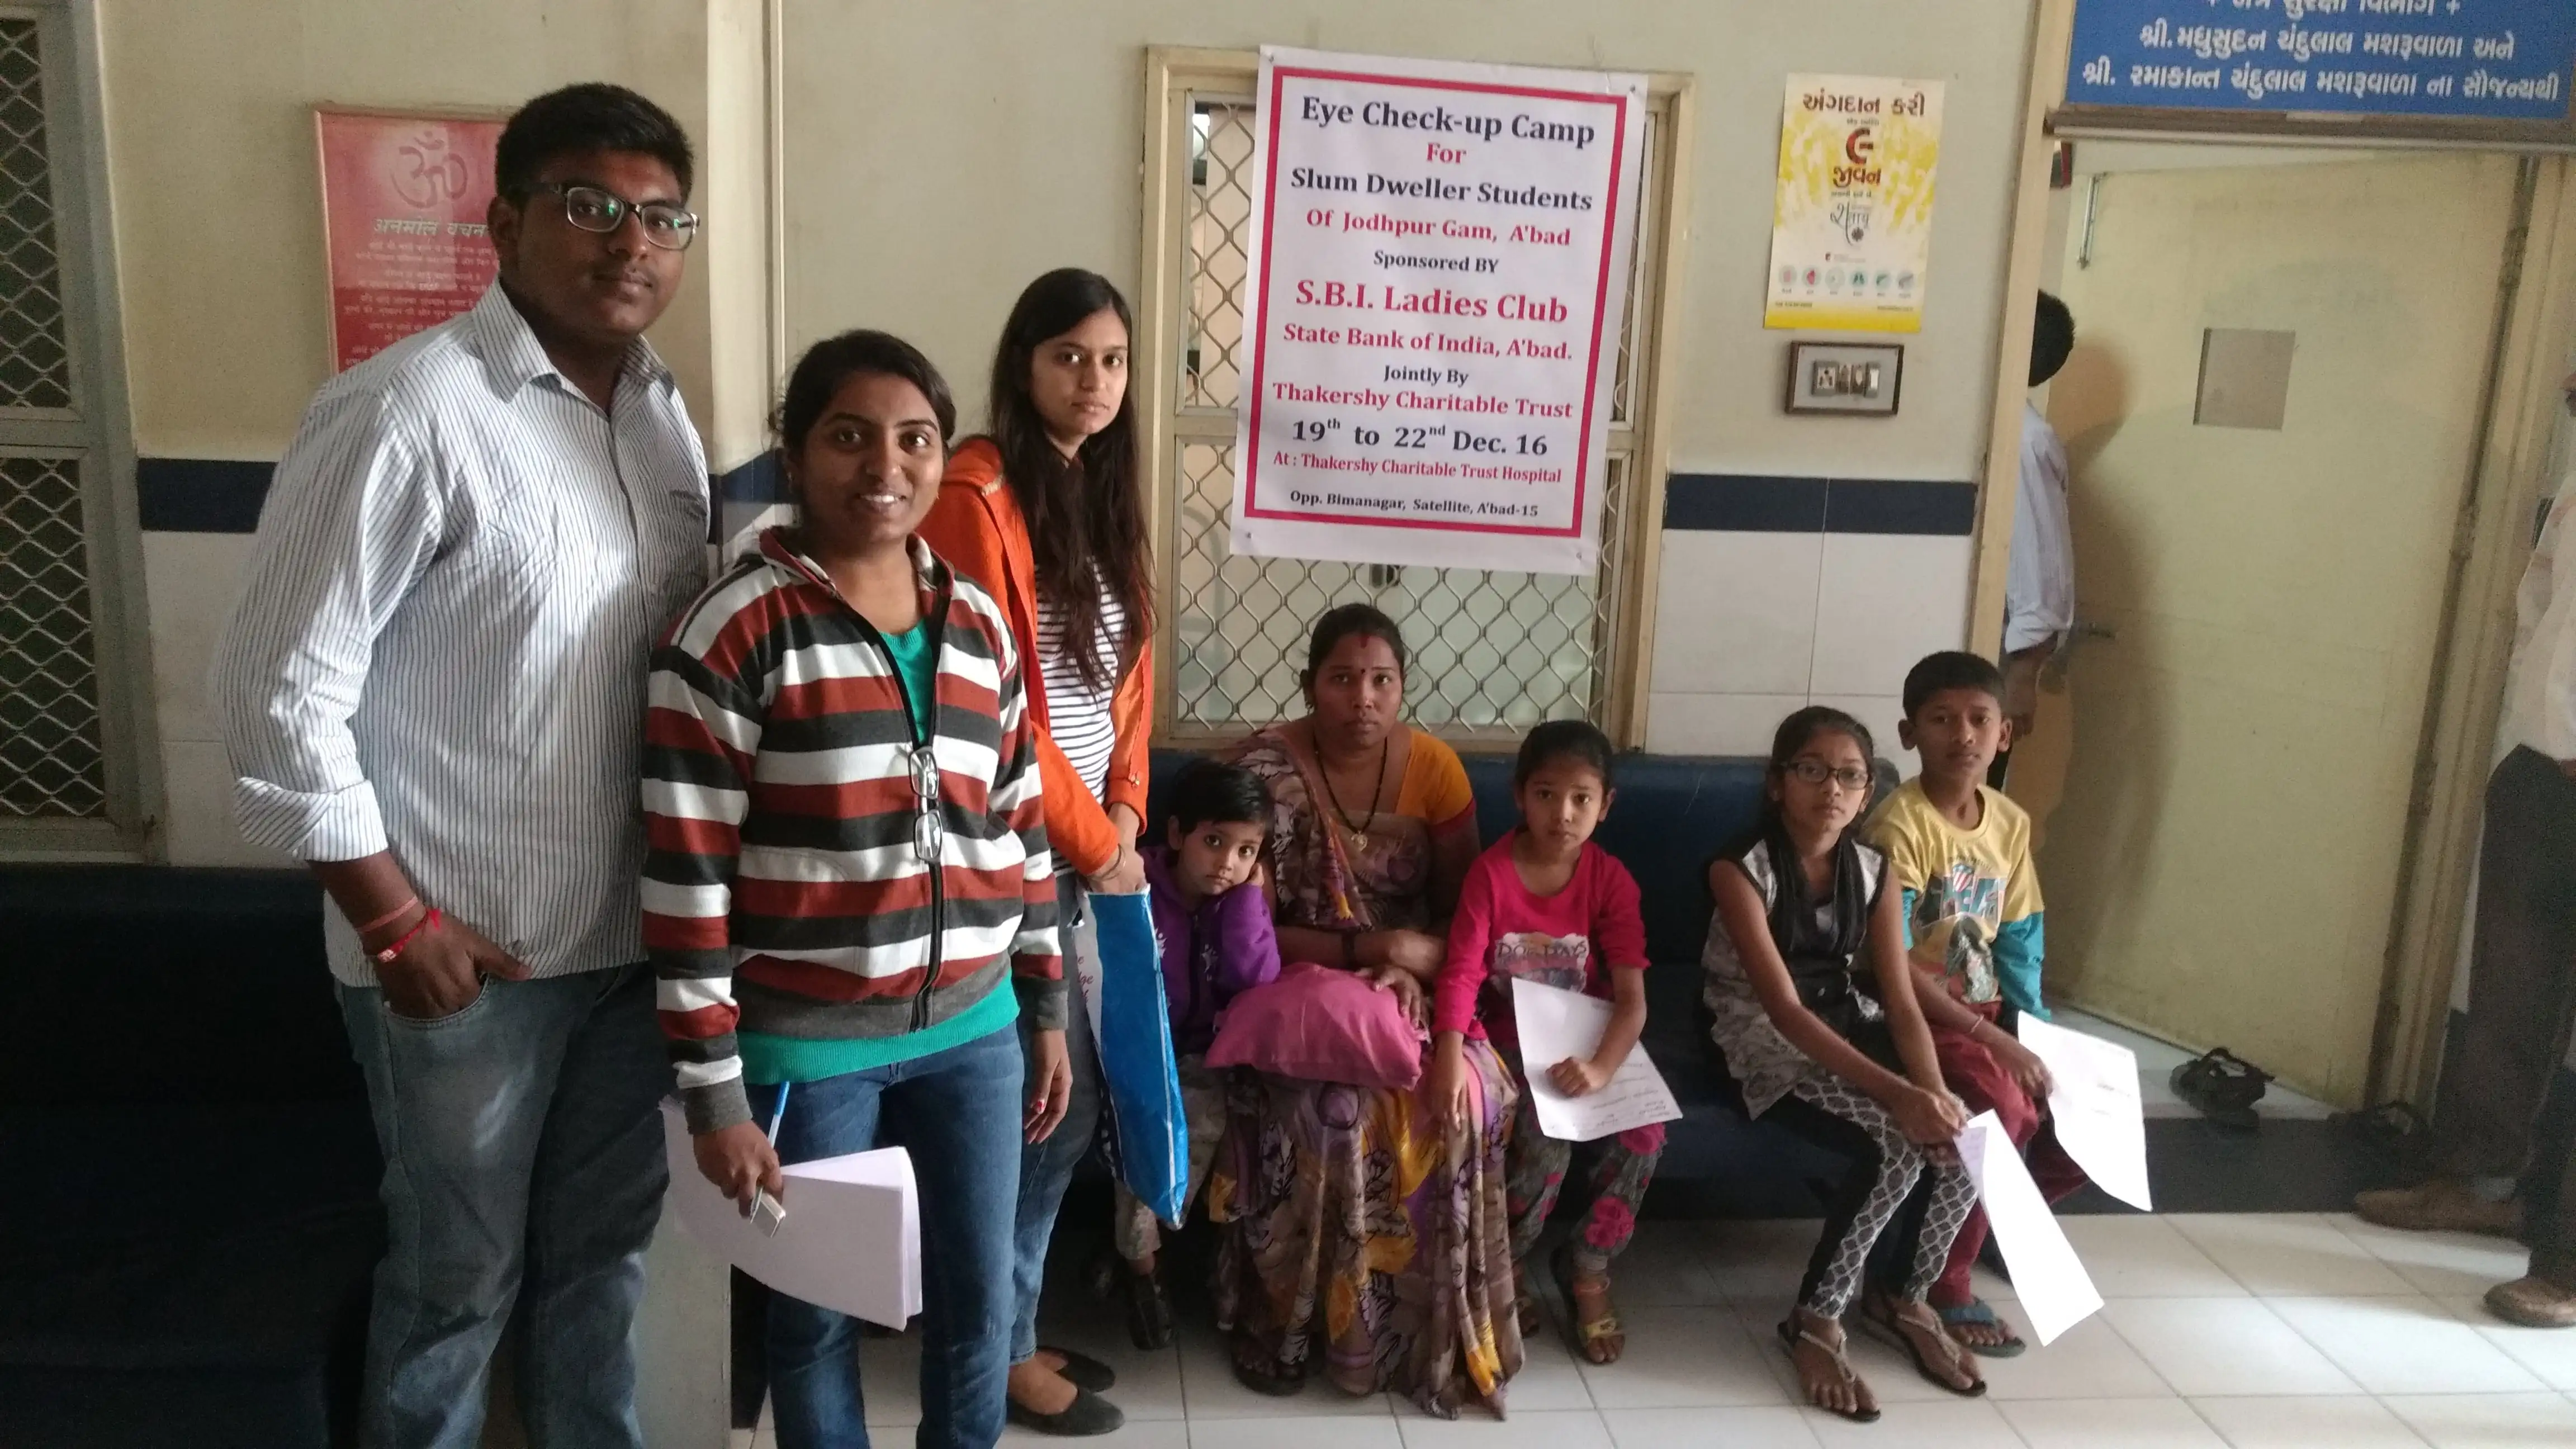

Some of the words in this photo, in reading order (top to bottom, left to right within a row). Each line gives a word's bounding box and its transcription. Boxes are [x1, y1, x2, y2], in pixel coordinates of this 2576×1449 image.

[2277, 22, 2354, 62] ચંદુલાલ
[2473, 30, 2515, 59] અને
[2082, 55, 2116, 86] શ્રી.
[2130, 65, 2220, 89] રમાકાન્ત
[2231, 61, 2307, 100] ચંદુલાલ
[2426, 75, 2452, 97] ના
[1803, 88, 1881, 115] અંગદાન
[1891, 92, 1925, 117] કરી
[1301, 96, 1353, 128] Eye
[1362, 101, 1502, 142] Check-up
[1511, 114, 1595, 150] Camp
[1427, 143, 1467, 164] For
[1291, 167, 1357, 192] Slum
[1367, 173, 1471, 201] Dweller
[1477, 182, 1593, 210] Students
[1832, 166, 1882, 188] જીવન
[373, 215, 438, 235] अनमोल
[1306, 209, 1334, 228] Of
[1343, 212, 1437, 238] Jodhpur
[1442, 220, 1497, 243] Gam,
[1509, 225, 1570, 246] A'bad
[1374, 250, 1470, 272] Sponsored
[1475, 258, 1499, 273] BY
[1296, 280, 1374, 309] S.B.I.
[1385, 286, 1488, 318] Ladies
[1497, 294, 1568, 323] Club
[1284, 323, 1341, 344] State
[1347, 328, 1404, 349] Bank
[1410, 332, 1434, 351] of
[1438, 334, 1500, 358] India,
[1506, 339, 1572, 360] A'bad.
[1384, 364, 1442, 387] Jointly
[1447, 368, 1469, 388] By
[1272, 382, 1390, 411] Thakershy
[1396, 391, 1509, 414] Charitable
[1515, 399, 1571, 418] Trust
[1354, 426, 1380, 446] to
[1453, 430, 1507, 454] Dec.
[1516, 434, 1547, 456] 16
[1273, 451, 1289, 466] At
[1301, 453, 1378, 475] Thakershy
[1381, 459, 1456, 477] Charitable
[1460, 463, 1498, 479] Trust
[1502, 466, 1561, 485] Hospital
[1290, 490, 1323, 506] Opp.
[1327, 493, 1406, 511] Bimanagar,
[1413, 499, 1473, 514] Satellite,
[1476, 502, 1538, 517] A'bad-15
